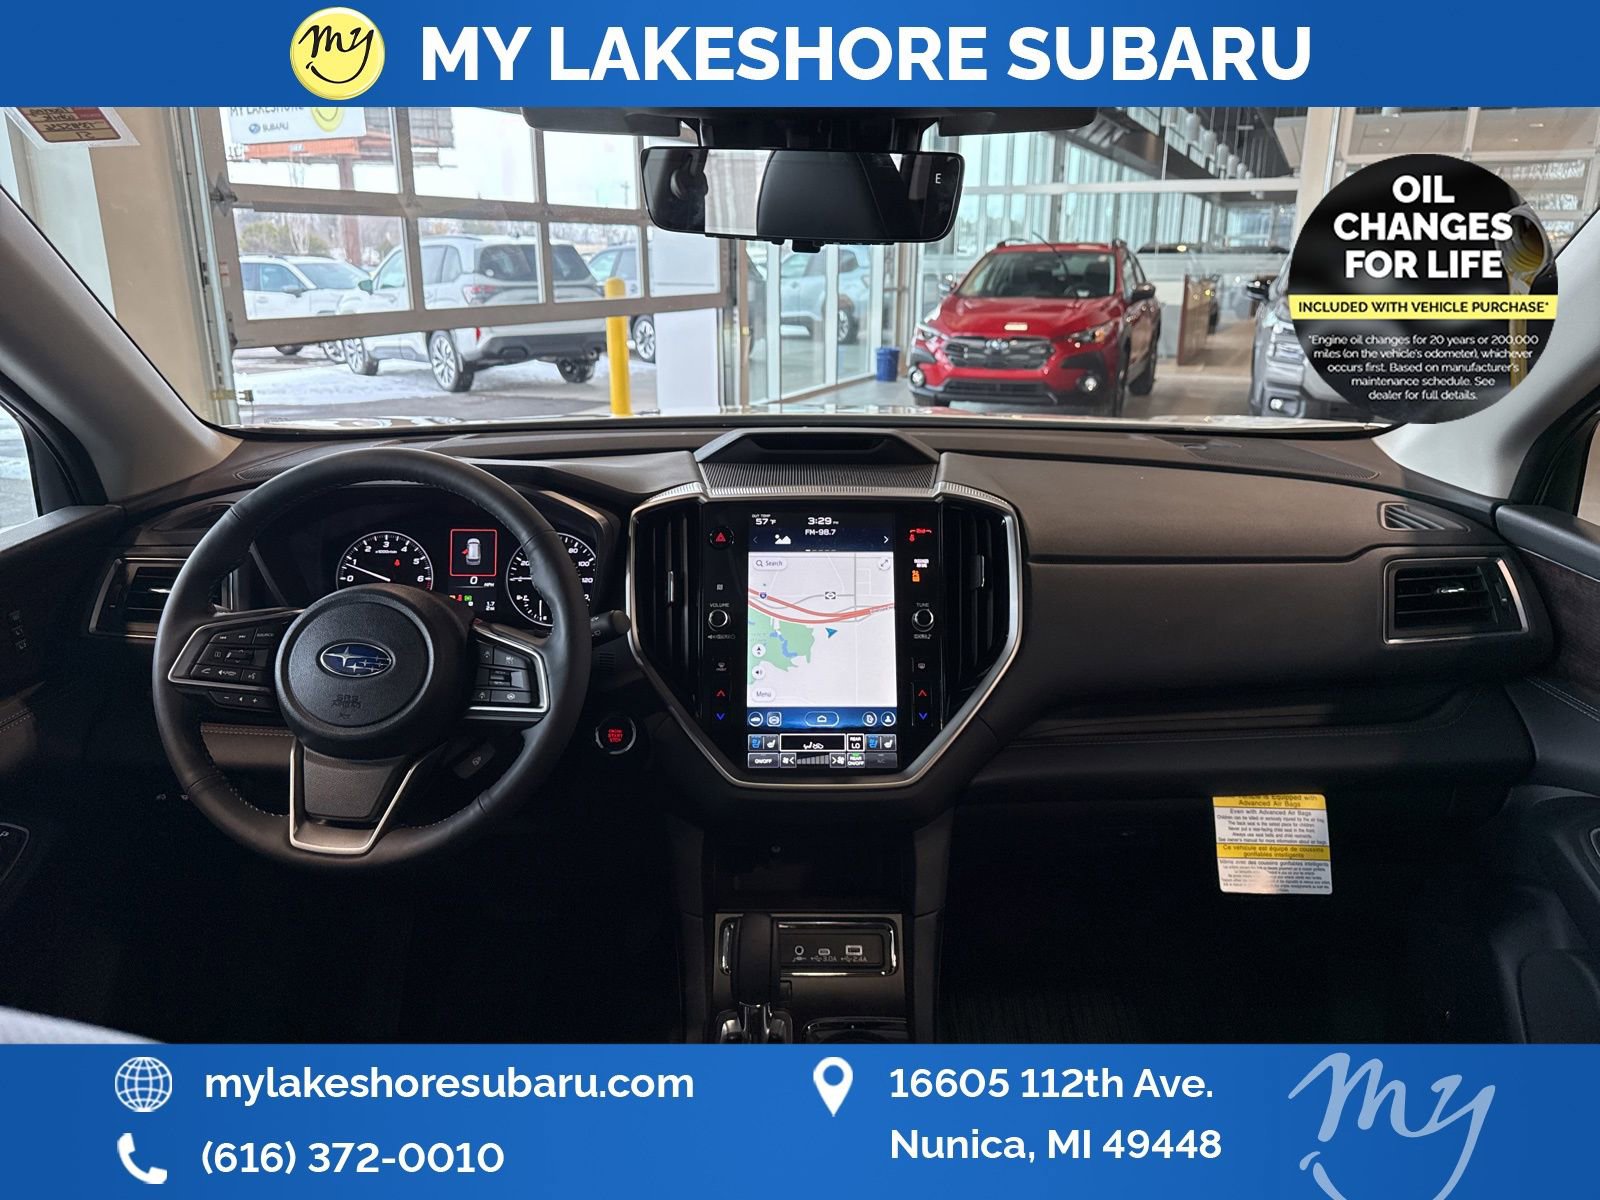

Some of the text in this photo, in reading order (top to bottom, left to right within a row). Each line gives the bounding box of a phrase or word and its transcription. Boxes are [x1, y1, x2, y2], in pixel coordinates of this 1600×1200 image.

[935, 173, 942, 184] E
[807, 516, 832, 525] 3:29
[470, 576, 478, 585] 0
